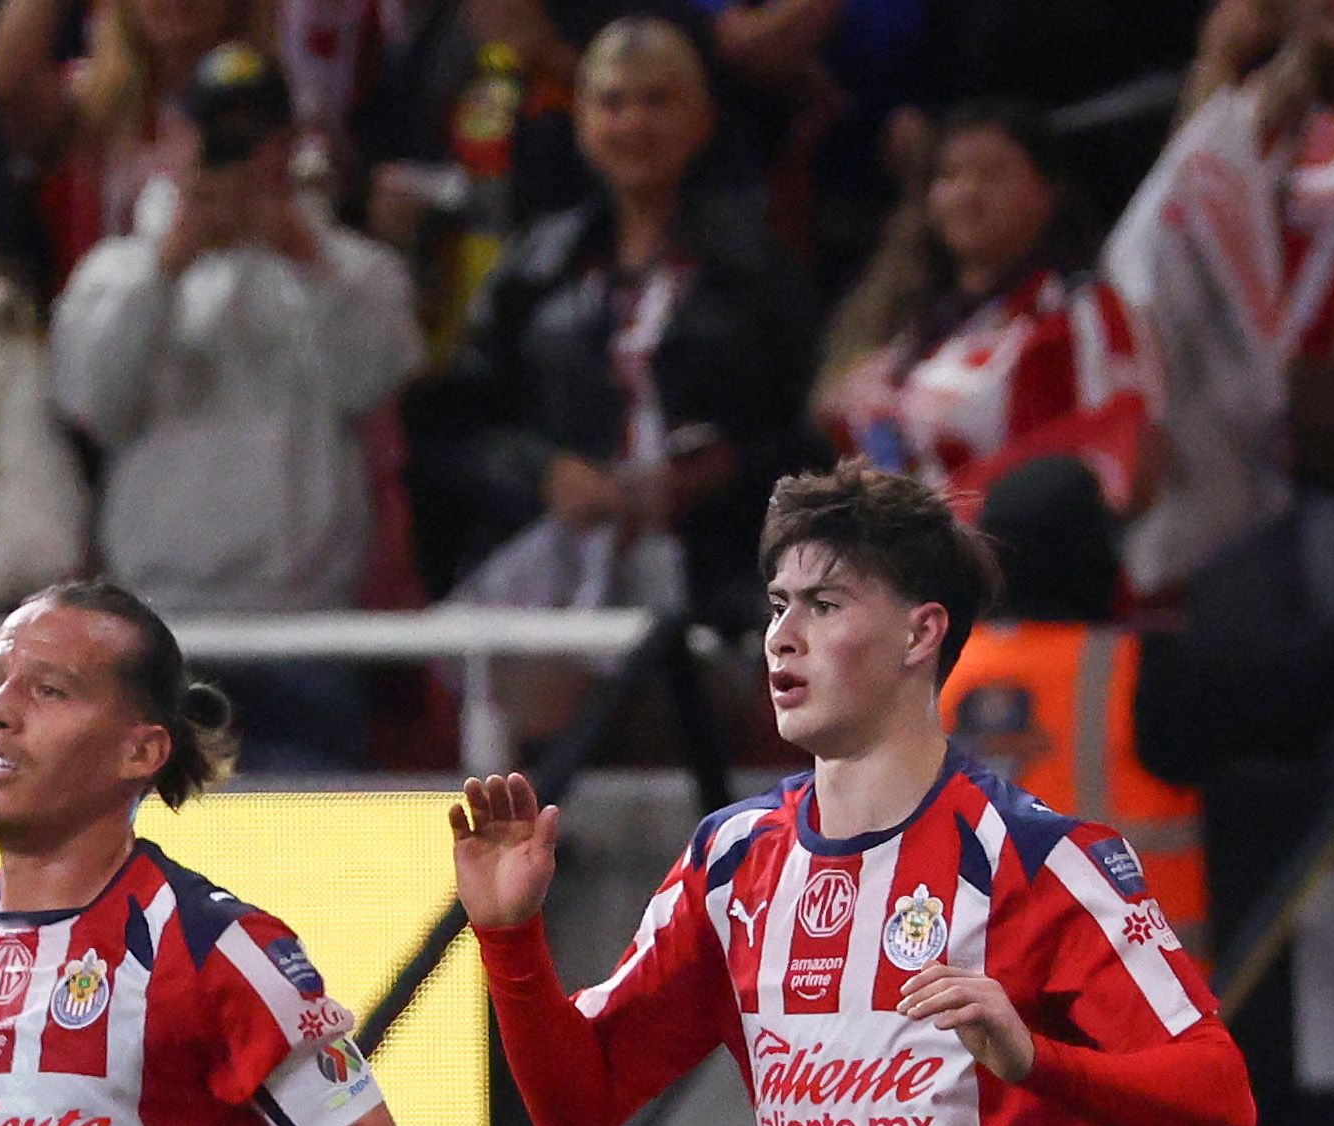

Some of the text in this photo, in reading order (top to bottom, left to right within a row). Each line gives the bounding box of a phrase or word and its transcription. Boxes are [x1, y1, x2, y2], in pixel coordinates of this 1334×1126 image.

[802, 874, 853, 932] MG
[790, 957, 844, 971] amazon
[791, 972, 832, 990] prime
